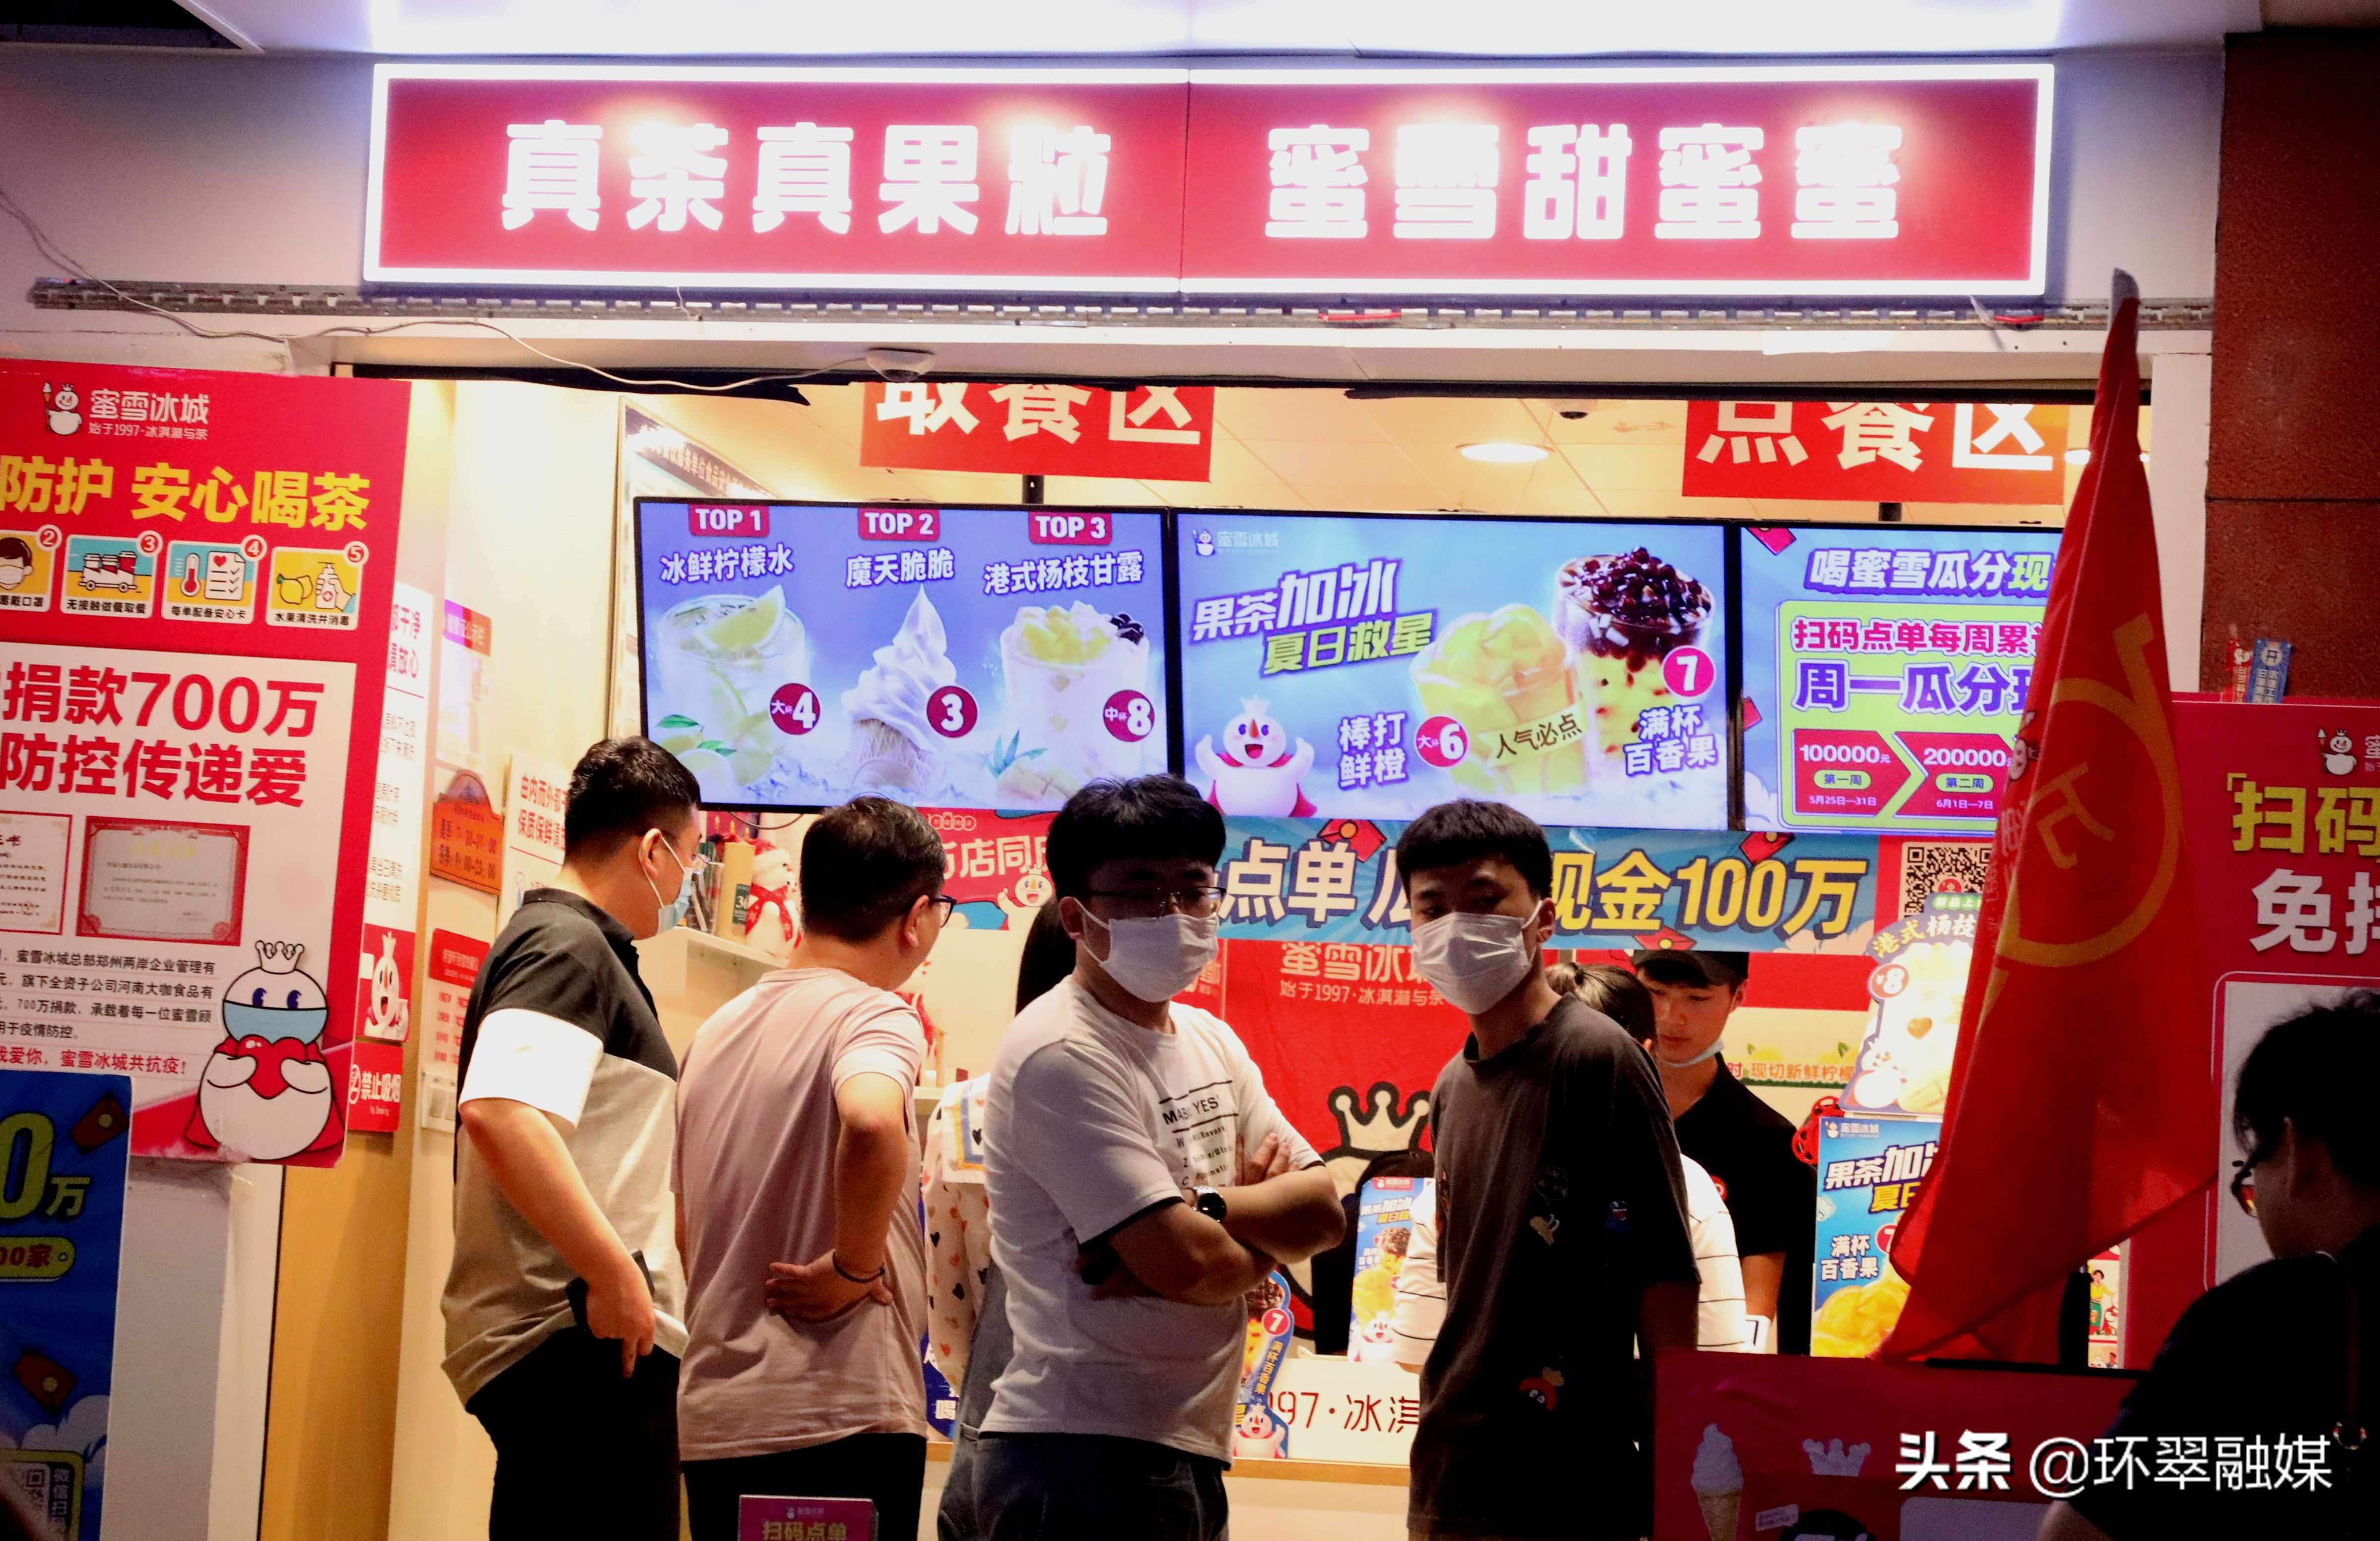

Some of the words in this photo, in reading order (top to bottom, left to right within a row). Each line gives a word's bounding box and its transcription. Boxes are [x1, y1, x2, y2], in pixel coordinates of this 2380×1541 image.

[501, 119, 1111, 237] 真茶真果粒
[1264, 123, 1904, 240] 蜜雪甜蜜蜜
[89, 388, 210, 425] 蜜雪冰城
[0, 455, 114, 516] 防护
[131, 462, 370, 531] 安心喝茶
[695, 508, 743, 531] TOP
[750, 510, 761, 531] 1
[865, 512, 914, 534] TOP
[919, 513, 934, 535] 2
[1035, 516, 1085, 539] TOP
[1090, 517, 1106, 539] 3
[660, 543, 793, 583] 冰鲜柠檬水
[845, 547, 954, 587] 魔天脆脆
[984, 551, 1143, 594] 港式杨枝甘露
[1810, 550, 2051, 591] 喝蜜雪瓜分现
[1193, 560, 1397, 641] 果茶加冰
[1264, 612, 1433, 675] 夏日救星
[1677, 656, 1698, 691] 7
[2, 661, 324, 738] 捐款700万
[940, 693, 964, 731] 3
[1339, 713, 1406, 751] 棒打
[1496, 713, 1582, 759] 人气必点
[1640, 705, 1702, 739] 满杯
[0, 732, 307, 808] 防控传递爱
[1339, 748, 1407, 789] 鲜橙
[1625, 737, 1716, 774] 百香果
[1823, 774, 1862, 786] 第一周
[1945, 778, 1984, 790] 第二周
[1831, 1235, 1870, 1258] 满杯
[1821, 1257, 1878, 1281] 百香果
[1269, 1313, 1284, 1332] 7
